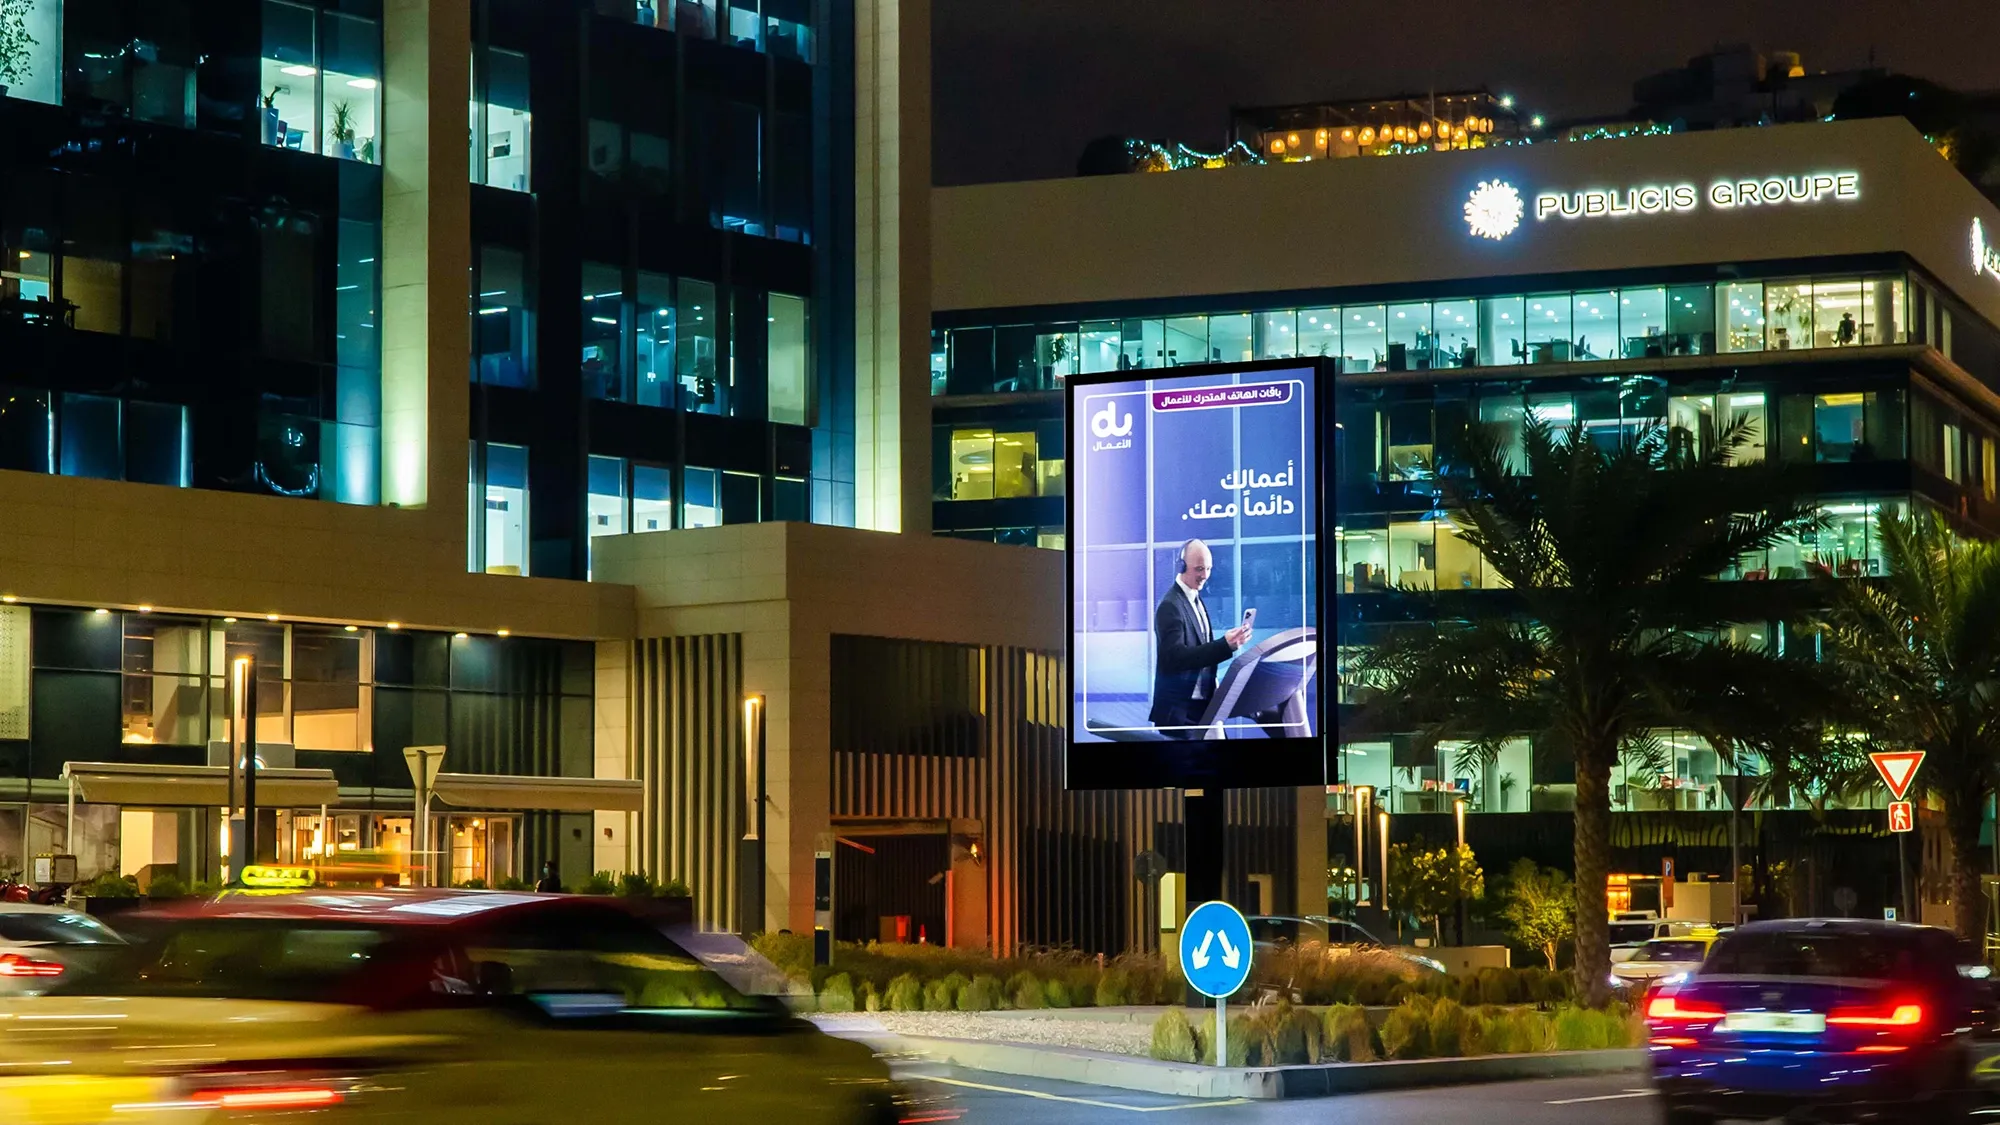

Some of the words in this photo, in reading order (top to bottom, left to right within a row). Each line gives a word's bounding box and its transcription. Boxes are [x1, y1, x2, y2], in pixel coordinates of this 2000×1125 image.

[1537, 187, 1695, 219] PUBLICIS
[1711, 174, 1859, 206] GROUPE
[1193, 392, 1226, 405] المتحرك
[1227, 390, 1257, 400] الهاتف
[1259, 387, 1281, 399] باقات
[1091, 400, 1133, 438] du
[1220, 459, 1294, 490] أعمالك
[1181, 499, 1238, 520] معك.
[1665, 861, 1671, 876] P
